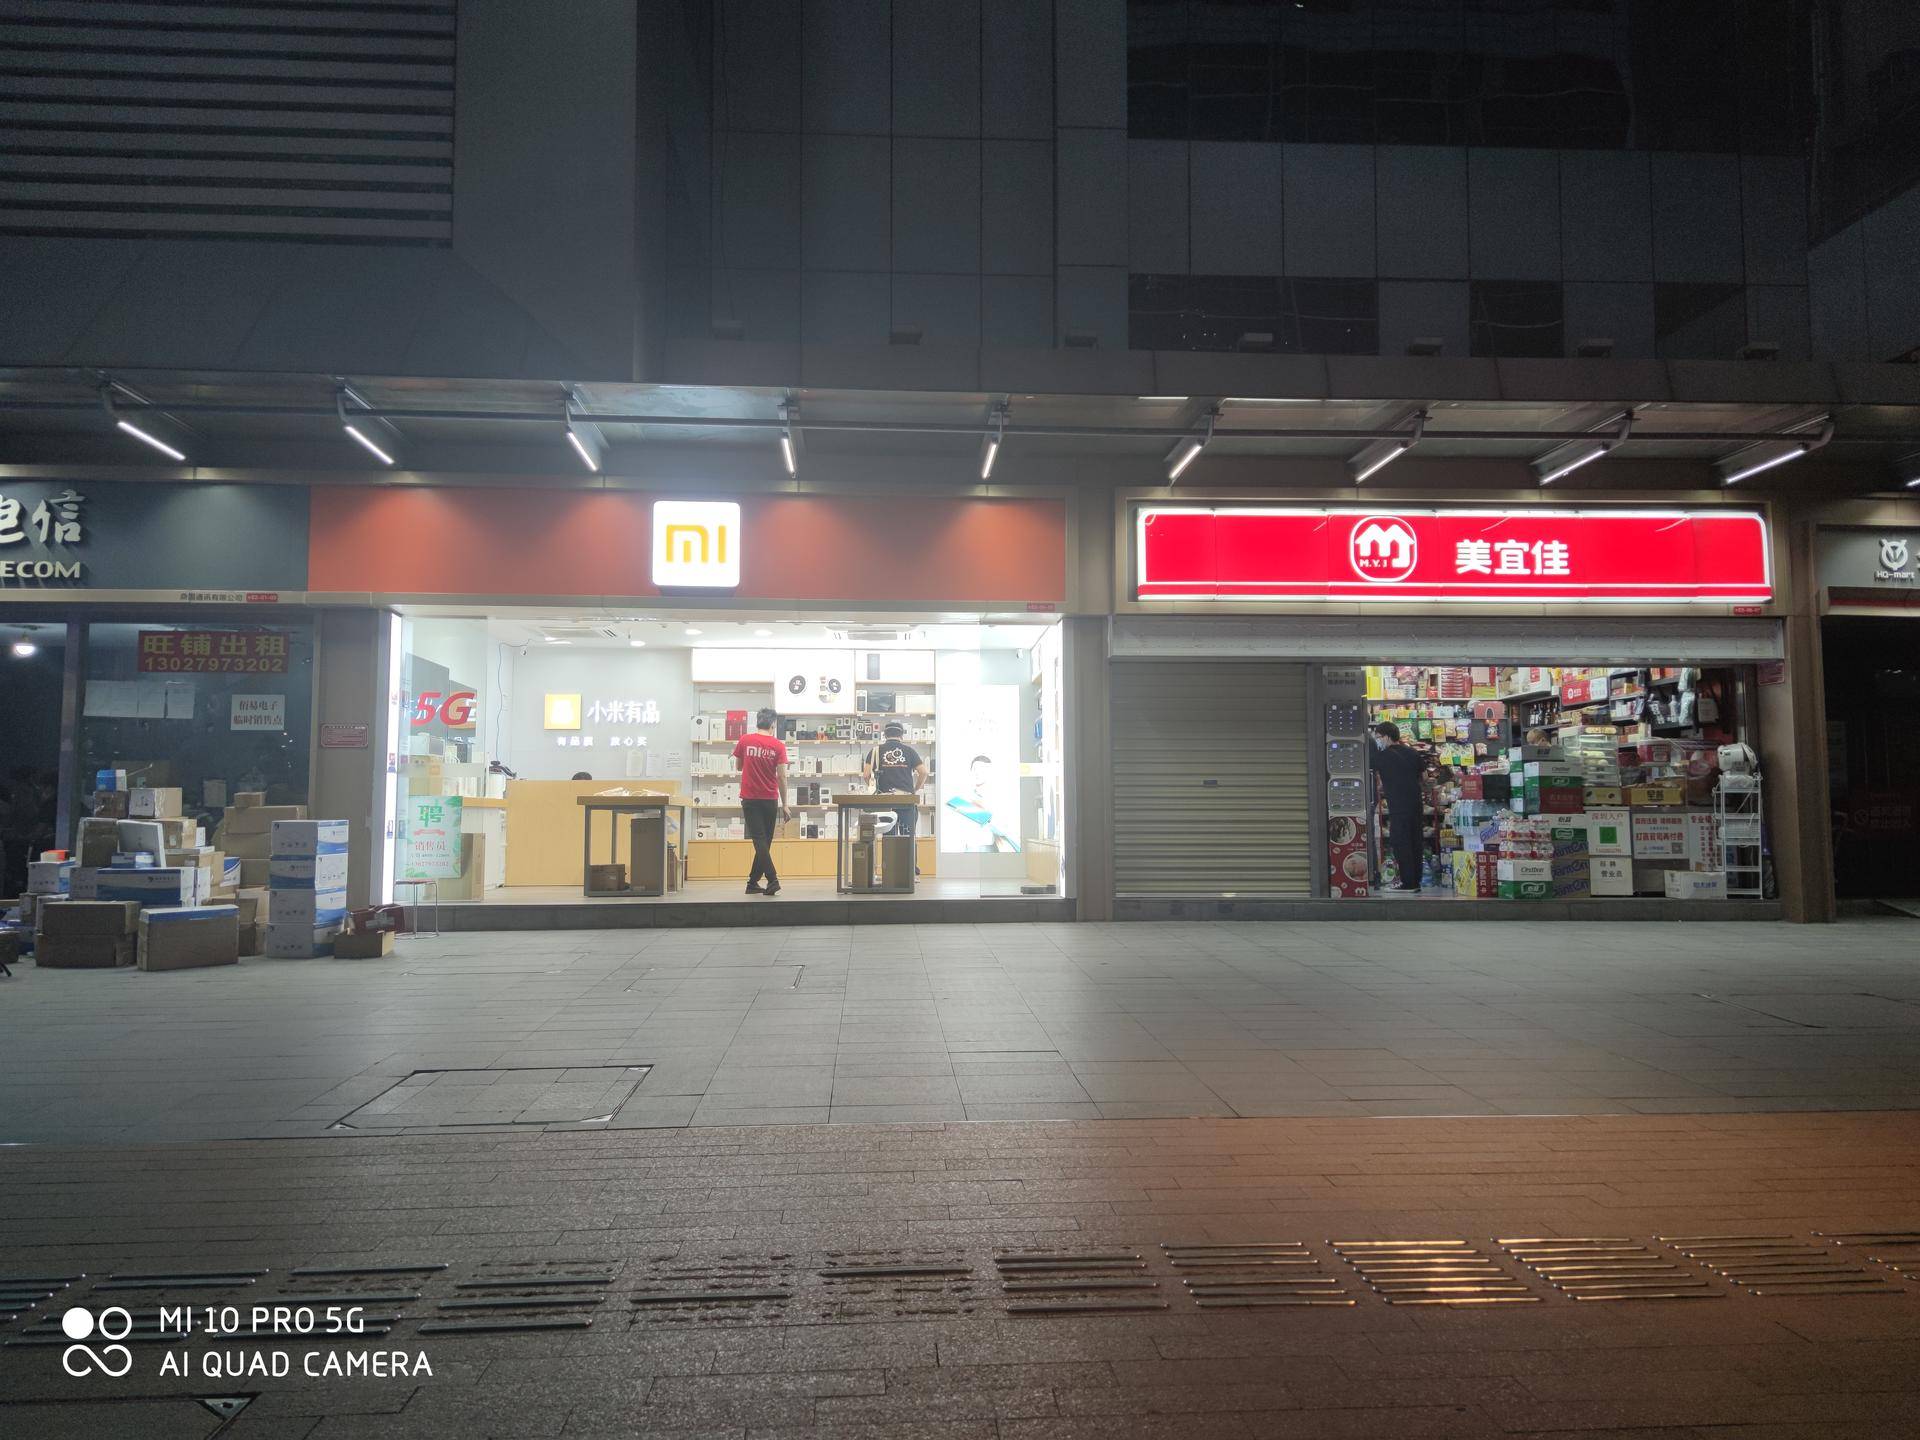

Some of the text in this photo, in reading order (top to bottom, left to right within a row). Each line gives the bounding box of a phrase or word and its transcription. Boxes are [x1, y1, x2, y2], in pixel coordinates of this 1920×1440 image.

[1455, 538, 1570, 576] 美宜佳
[143, 634, 286, 657] 旺铺出租
[144, 656, 283, 672] 13027973202
[410, 690, 476, 727] 5G
[586, 699, 661, 725] 小米有品
